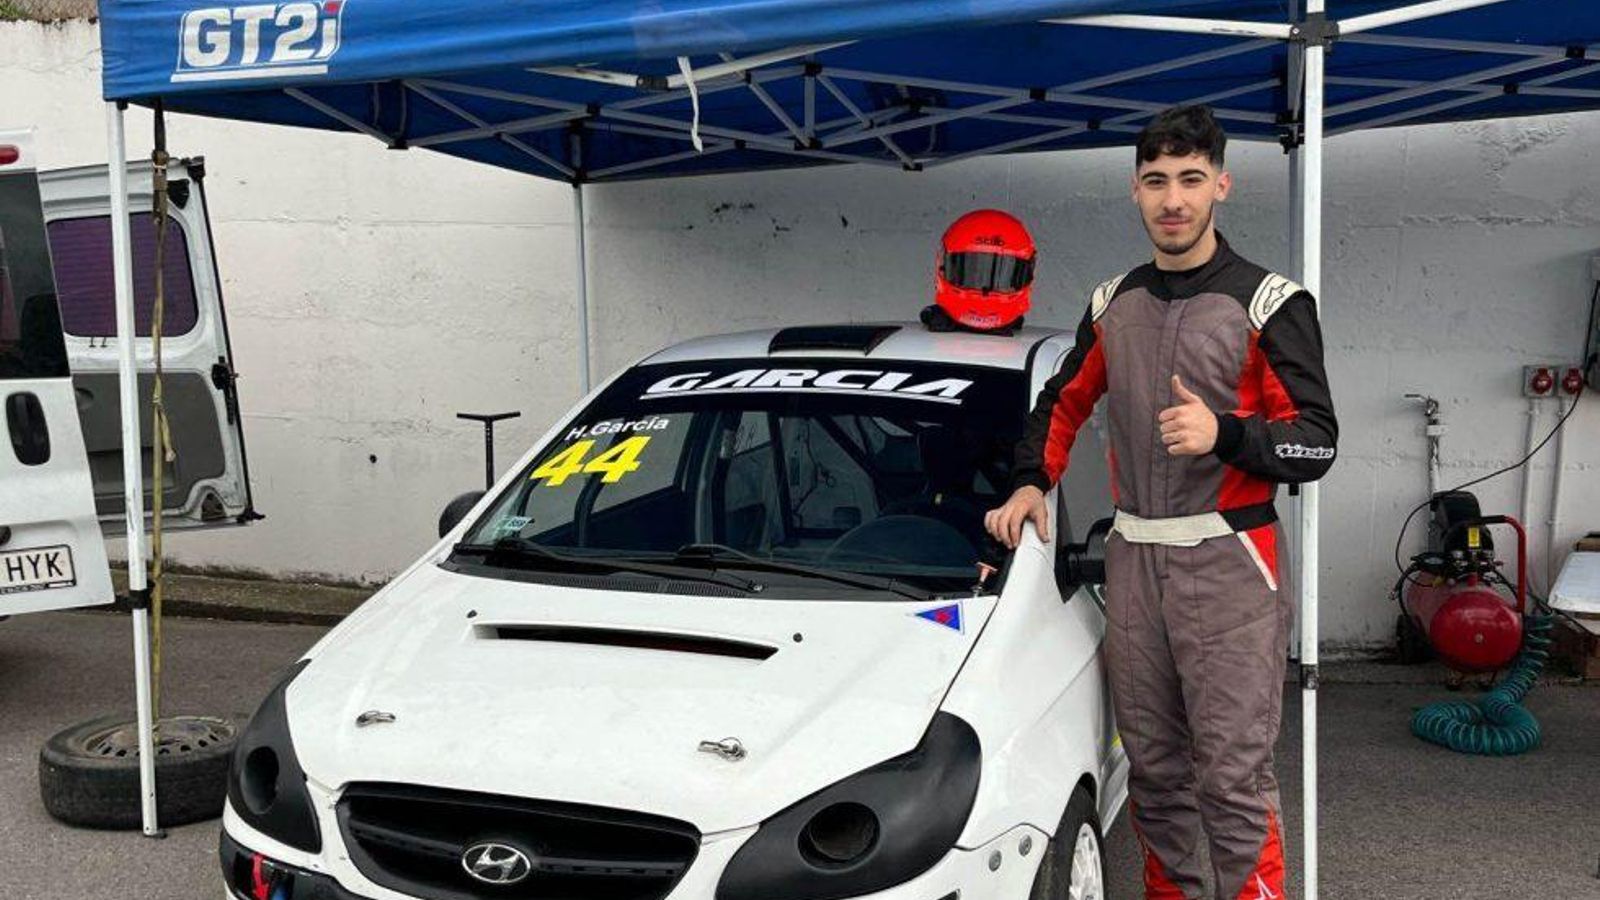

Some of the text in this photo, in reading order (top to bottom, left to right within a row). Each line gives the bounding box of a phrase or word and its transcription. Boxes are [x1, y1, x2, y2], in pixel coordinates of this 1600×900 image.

[184, 1, 340, 67] GT2i
[646, 368, 975, 399] GARCIA
[530, 435, 651, 487] 44
[5, 552, 63, 582] HYK
